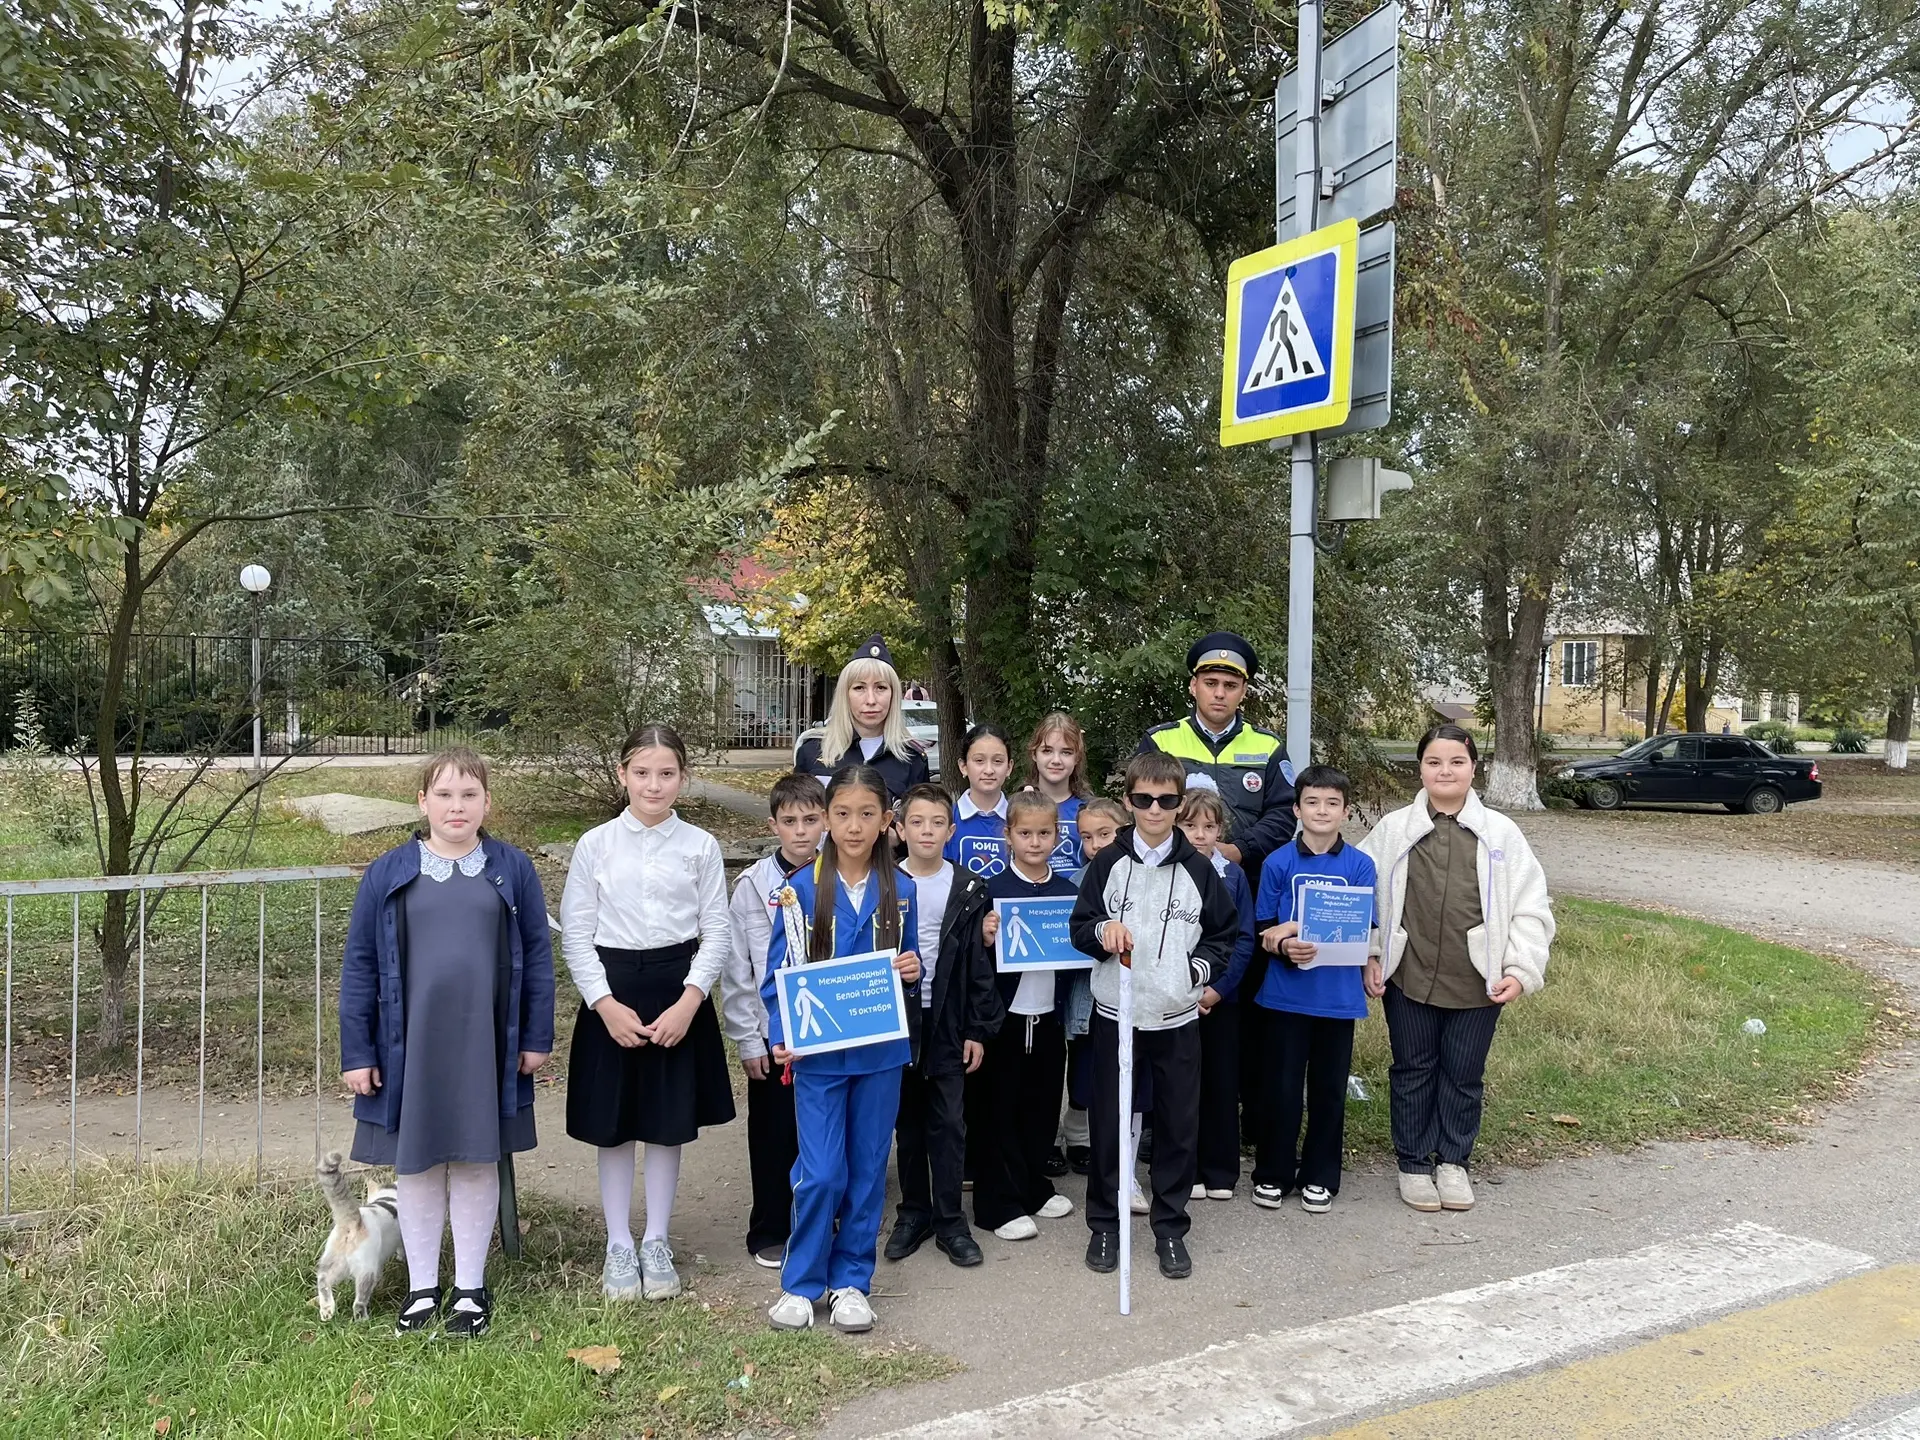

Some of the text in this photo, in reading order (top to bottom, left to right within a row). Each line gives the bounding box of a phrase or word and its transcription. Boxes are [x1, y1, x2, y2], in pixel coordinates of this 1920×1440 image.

[972, 841, 999, 852] ЮИД
[1028, 908, 1073, 917] Международ
[1042, 922, 1063, 930] Белой
[819, 968, 886, 985] Международный
[868, 979, 888, 987] день
[836, 986, 889, 1000] Белой трости
[859, 1004, 891, 1014] октября
